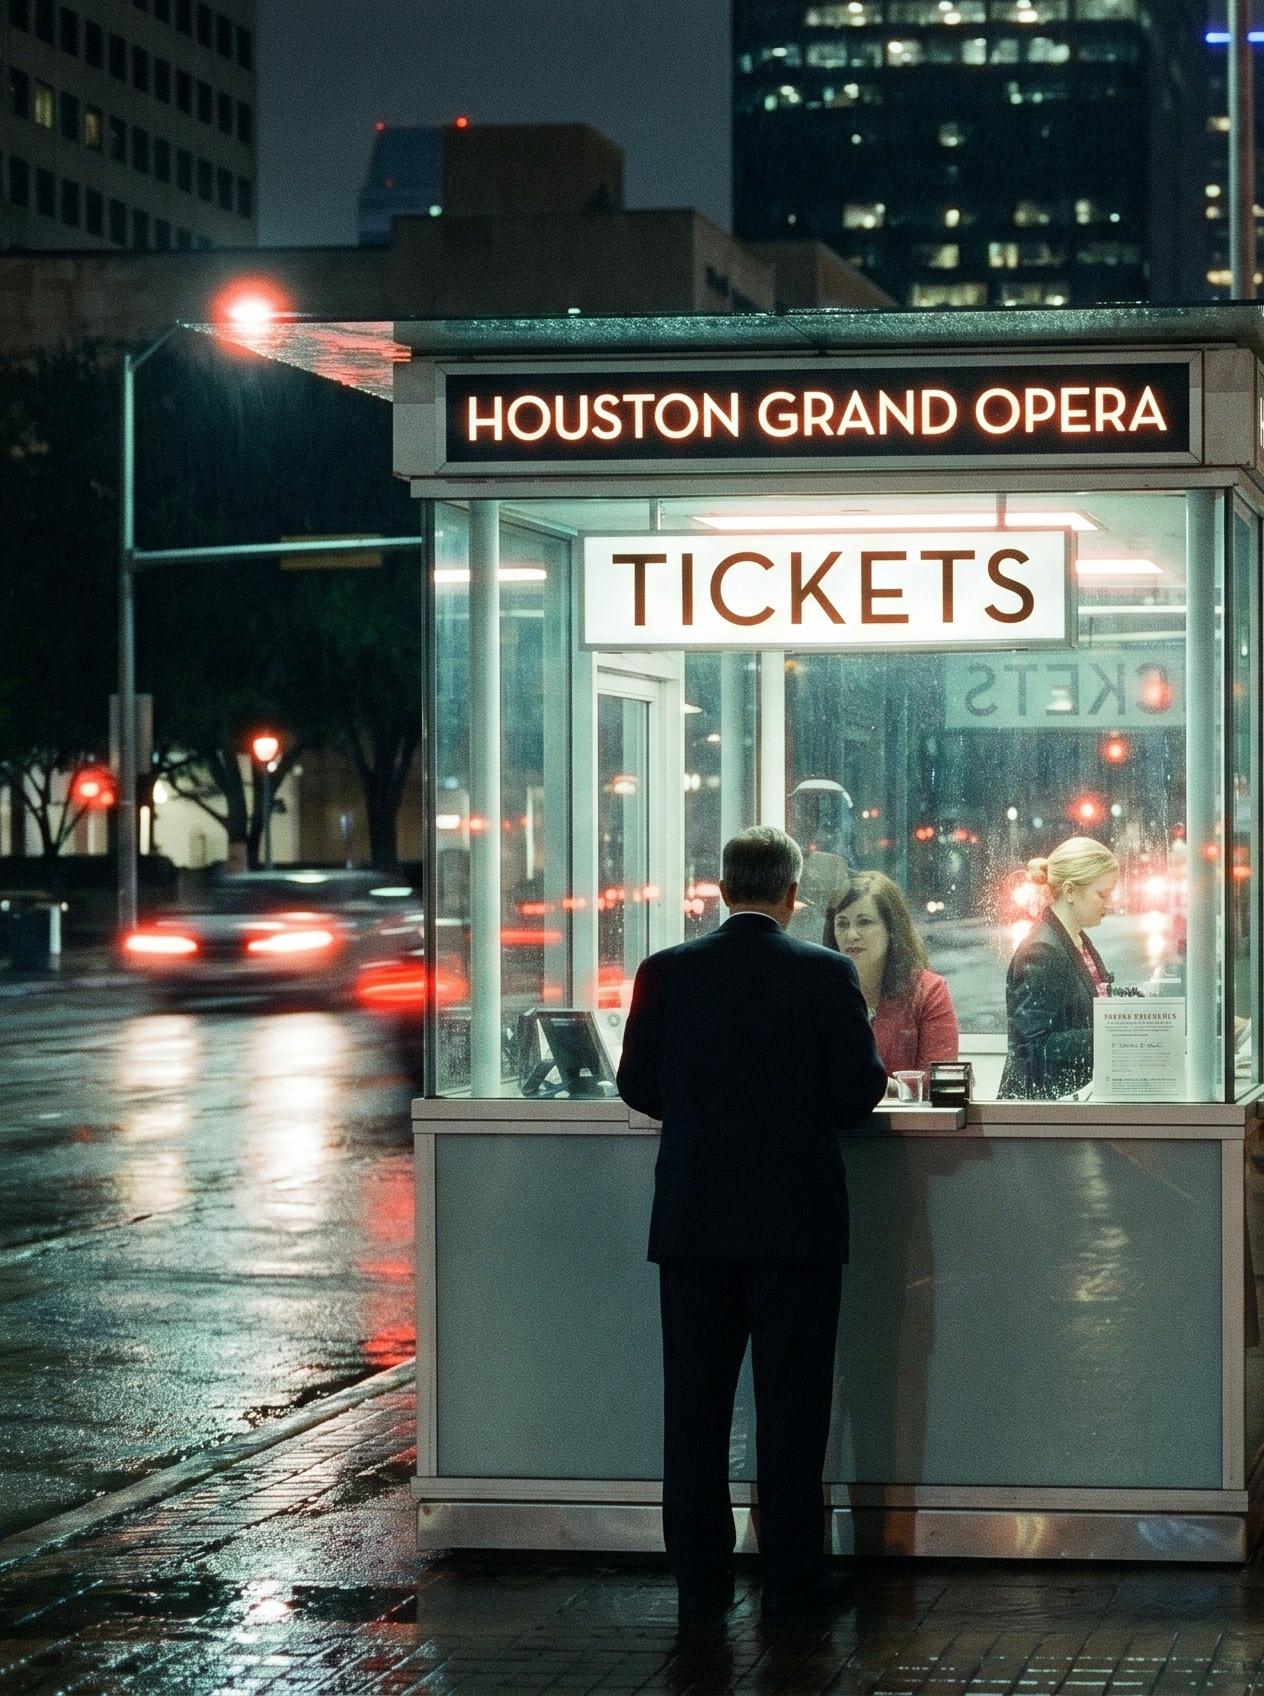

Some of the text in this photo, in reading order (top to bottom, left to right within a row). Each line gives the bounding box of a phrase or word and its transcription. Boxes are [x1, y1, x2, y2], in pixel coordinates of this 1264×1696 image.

[467, 384, 1168, 442] HOUSTON GRAND OPERA
[612, 548, 1035, 626] TICKETS
